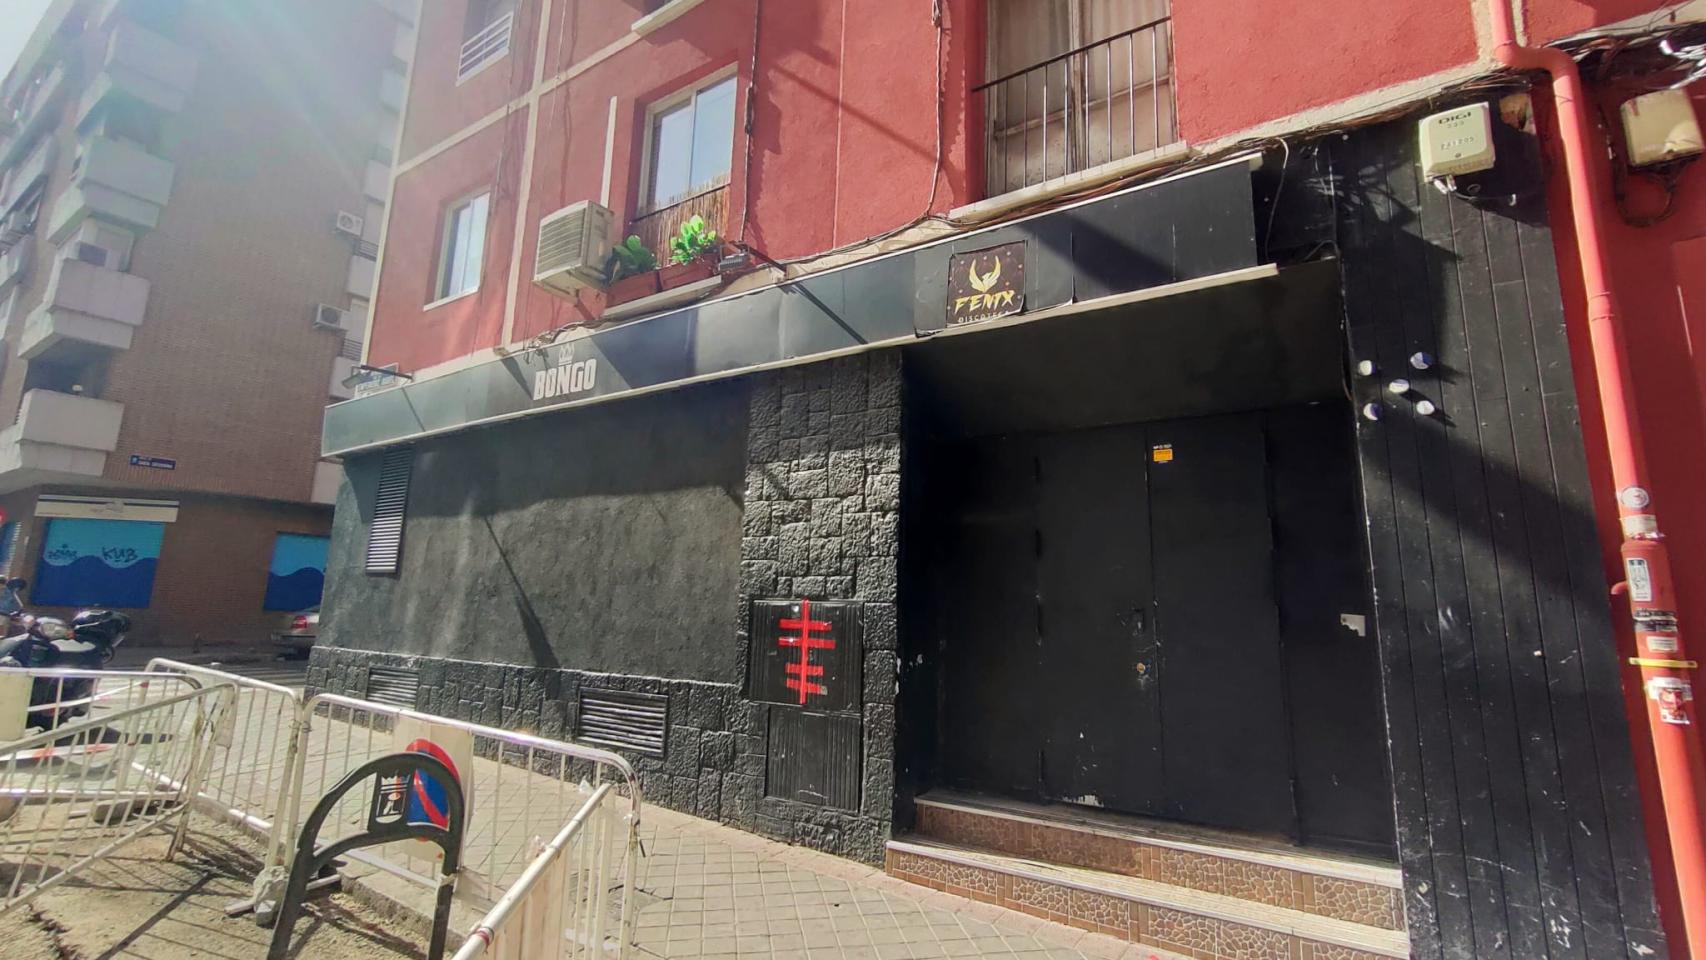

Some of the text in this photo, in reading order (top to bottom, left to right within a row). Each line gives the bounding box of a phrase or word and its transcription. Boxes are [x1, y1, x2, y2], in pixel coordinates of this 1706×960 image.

[1438, 111, 1472, 124] DIGI
[957, 310, 1009, 323] DISCOTEC
[533, 358, 597, 401] BONGO
